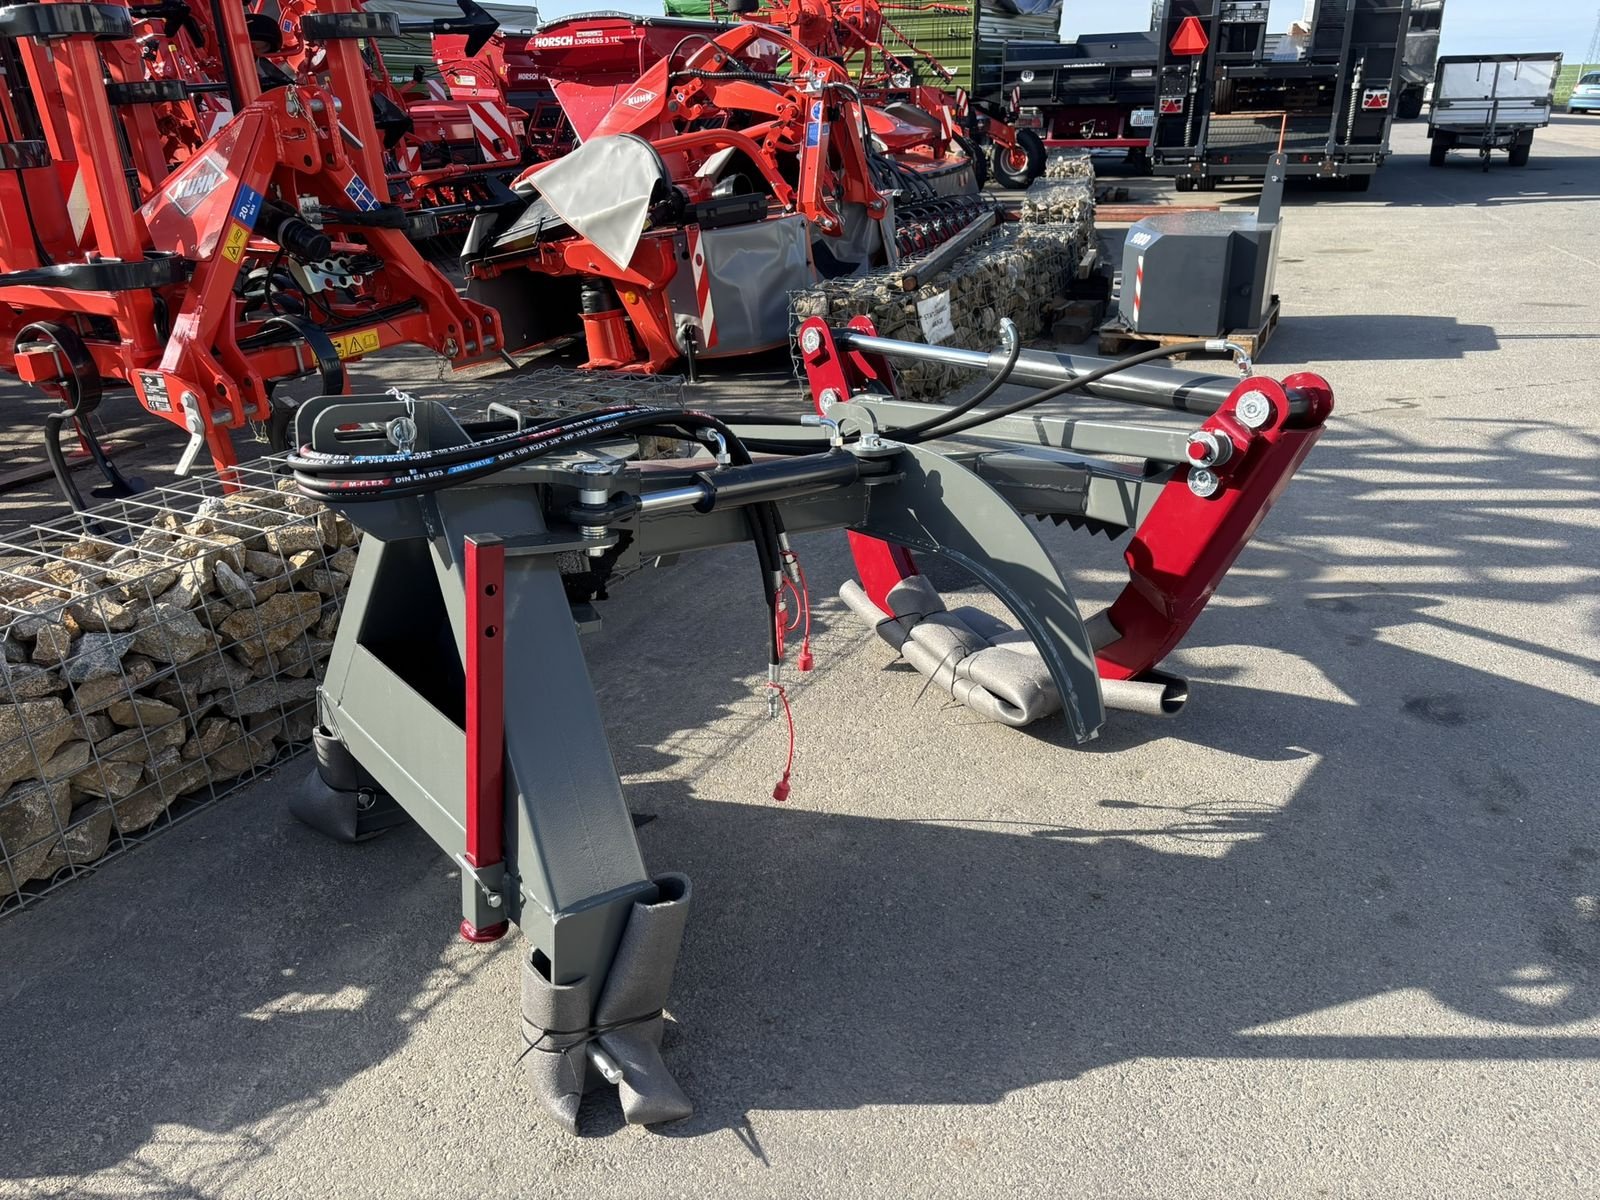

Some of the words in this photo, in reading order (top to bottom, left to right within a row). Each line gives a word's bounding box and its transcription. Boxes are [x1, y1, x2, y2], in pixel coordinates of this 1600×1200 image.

[534, 36, 573, 47] HORSCH
[574, 37, 603, 45] EXPRESS
[517, 72, 539, 80] HORSCH
[628, 92, 653, 105] KUHN
[173, 172, 219, 201] KUHN
[239, 206, 248, 220] 20
[348, 480, 385, 488] M-FLEX
[395, 475, 412, 484] DIN
[413, 473, 427, 481] EN
[427, 470, 444, 478] 853
[498, 452, 515, 461] SAE
[528, 441, 549, 452] R2AT
[562, 433, 575, 441] WP
[574, 429, 588, 437] 330
[586, 425, 602, 434] BAR
